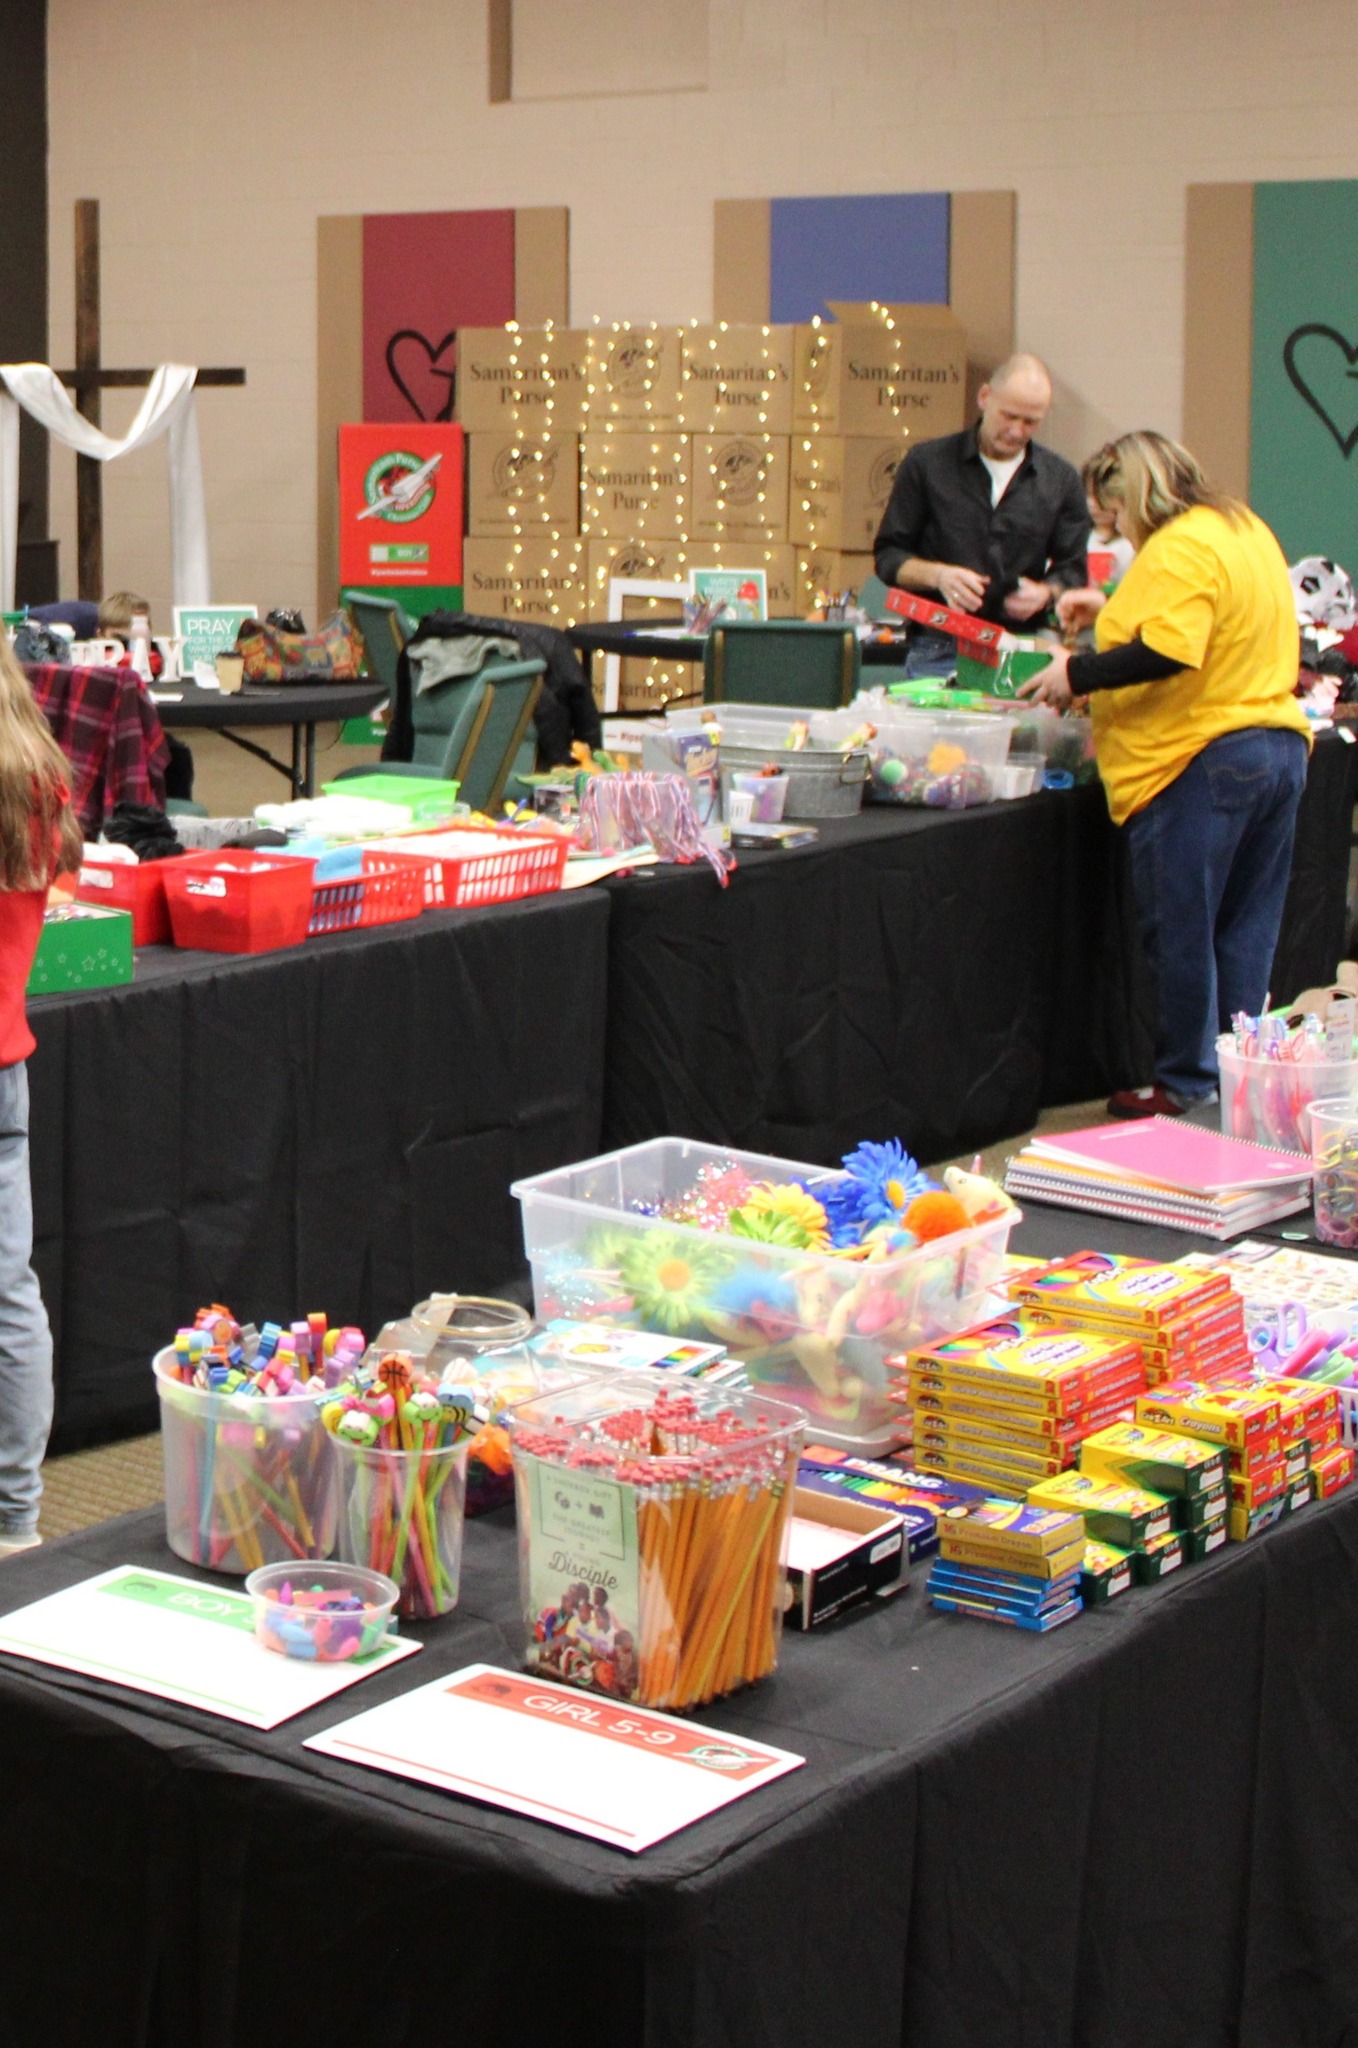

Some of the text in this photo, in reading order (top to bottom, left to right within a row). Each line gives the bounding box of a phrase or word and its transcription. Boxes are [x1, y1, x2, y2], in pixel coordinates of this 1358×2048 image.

[471, 362, 583, 381] Samritan's
[690, 362, 788, 381] Samarita's
[588, 466, 683, 486] Samaritan'
[613, 491, 660, 510] Pure
[187, 619, 234, 635] PRAY
[1180, 1416, 1222, 1434] Crayons
[843, 1458, 944, 1488] PRANG
[548, 1551, 618, 1589] Disciple
[169, 1592, 246, 1616] BOY
[523, 1695, 676, 1745] GIRL 5-9
